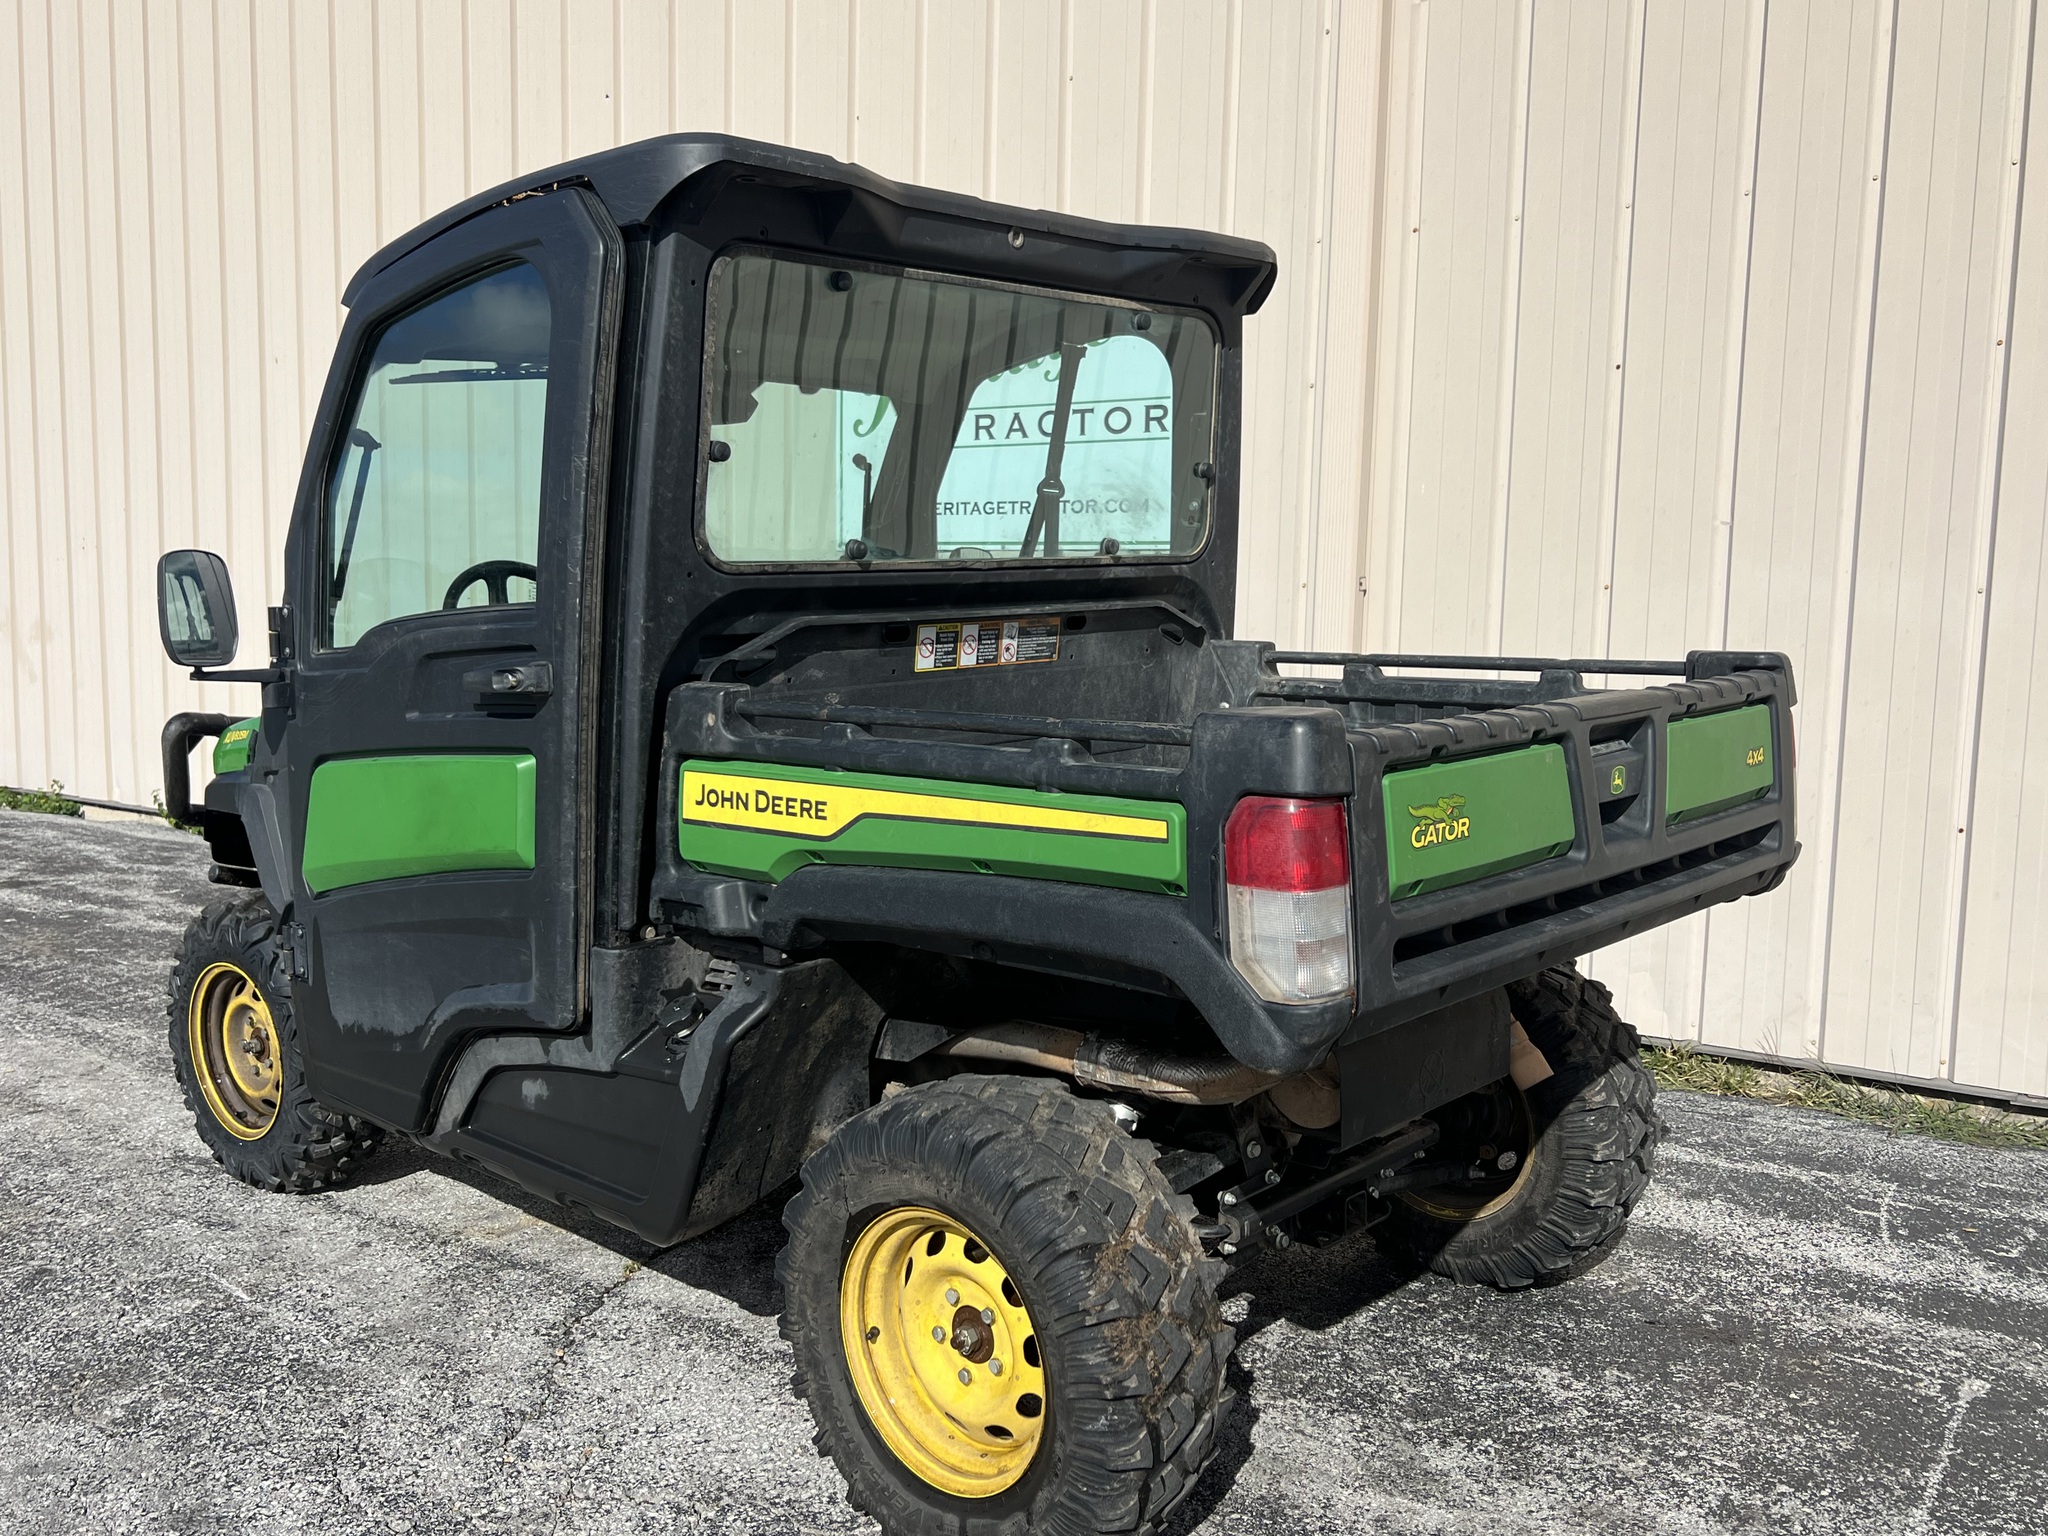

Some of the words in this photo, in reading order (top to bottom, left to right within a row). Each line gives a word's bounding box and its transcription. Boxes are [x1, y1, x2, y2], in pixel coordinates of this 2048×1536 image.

[974, 405, 1169, 441] RACTOR
[936, 498, 1149, 516] ERITAGETRTOR.COM
[695, 784, 749, 811] JOHN
[755, 790, 828, 820] DEERE
[1411, 817, 1470, 849] GATOR
